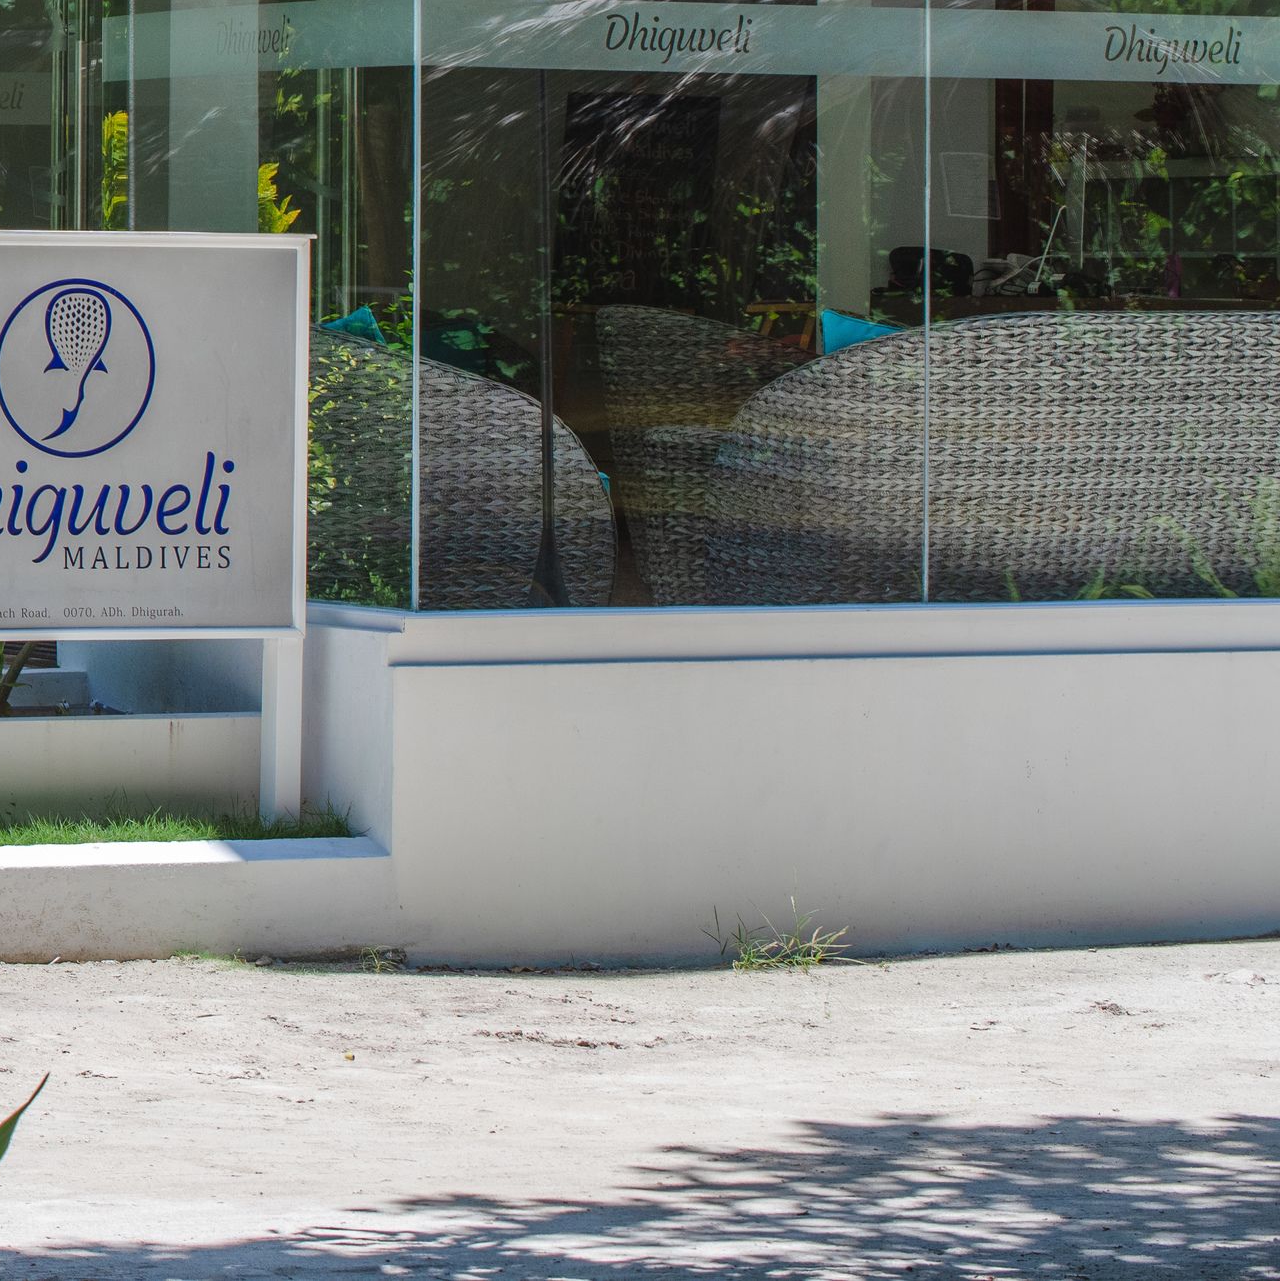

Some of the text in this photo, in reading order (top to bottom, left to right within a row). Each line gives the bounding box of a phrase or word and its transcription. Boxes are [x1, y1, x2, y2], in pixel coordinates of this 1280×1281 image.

[606, 12, 753, 64] Dhiguveli
[1104, 24, 1243, 75] Dhiguveli
[63, 545, 232, 570] MALDIVES
